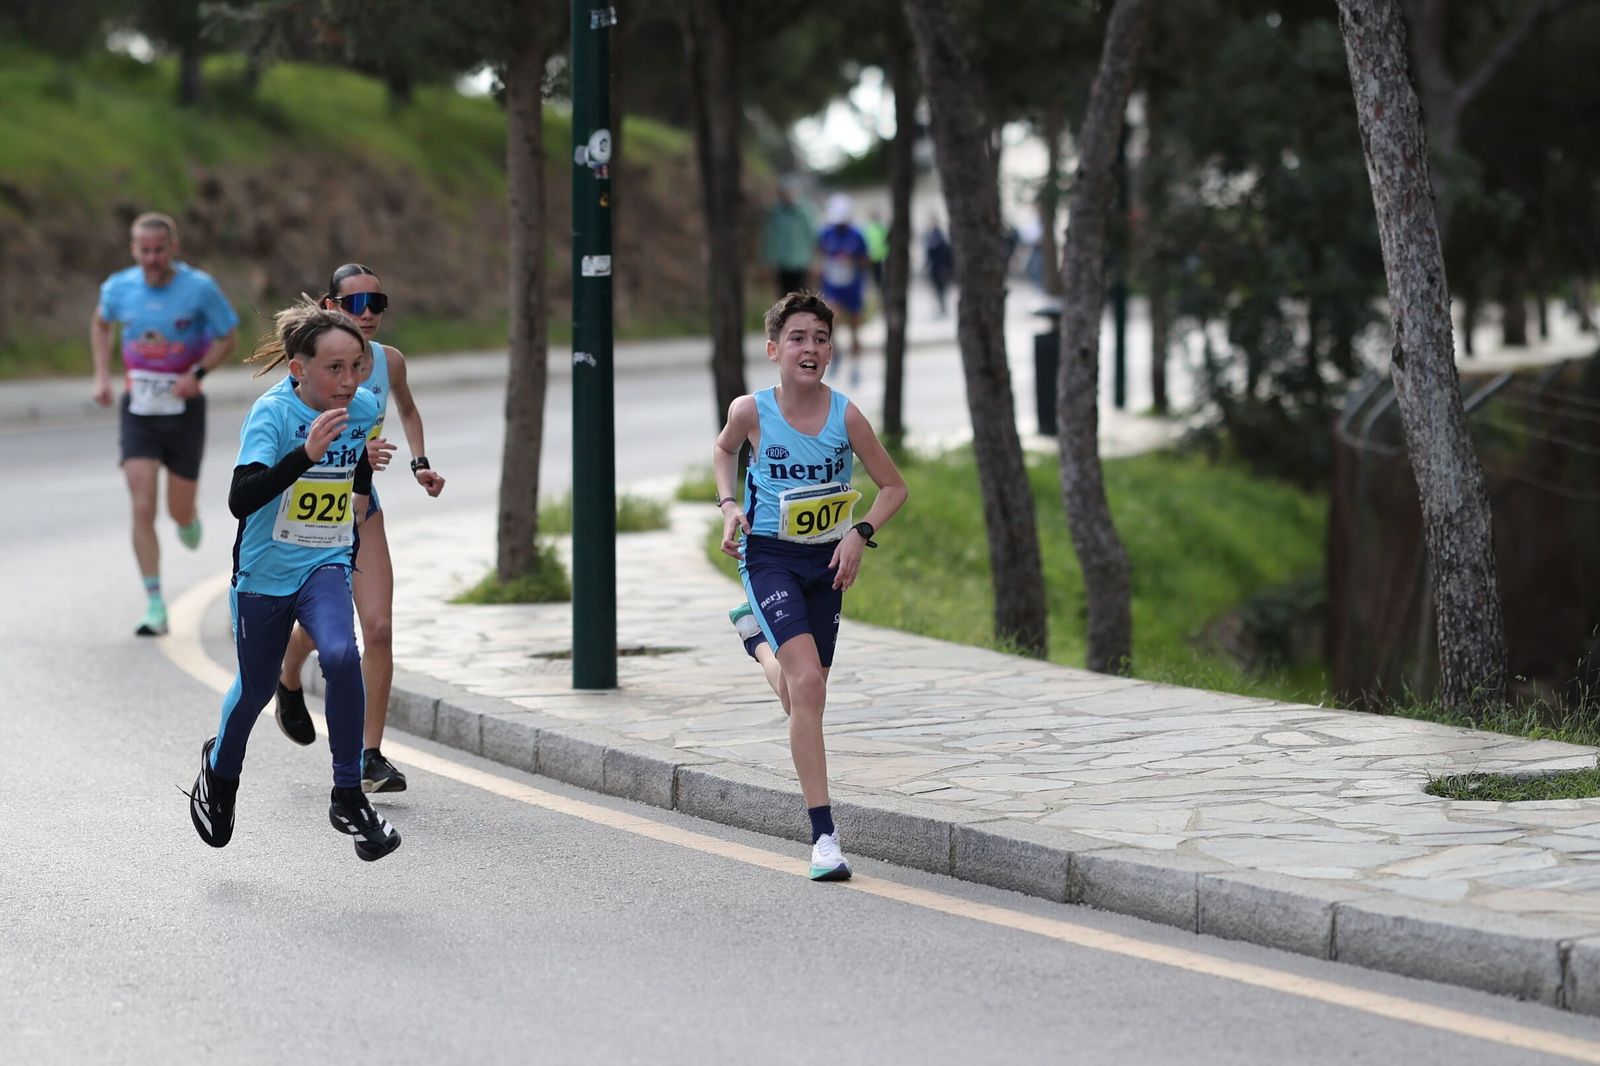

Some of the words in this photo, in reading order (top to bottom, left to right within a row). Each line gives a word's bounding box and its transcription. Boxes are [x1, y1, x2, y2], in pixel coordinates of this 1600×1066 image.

[315, 444, 358, 469] rja
[766, 447, 790, 459] TROPS
[769, 457, 845, 484] nerja
[296, 492, 348, 522] 929
[796, 501, 849, 535] 907
[760, 590, 789, 609] nerja
